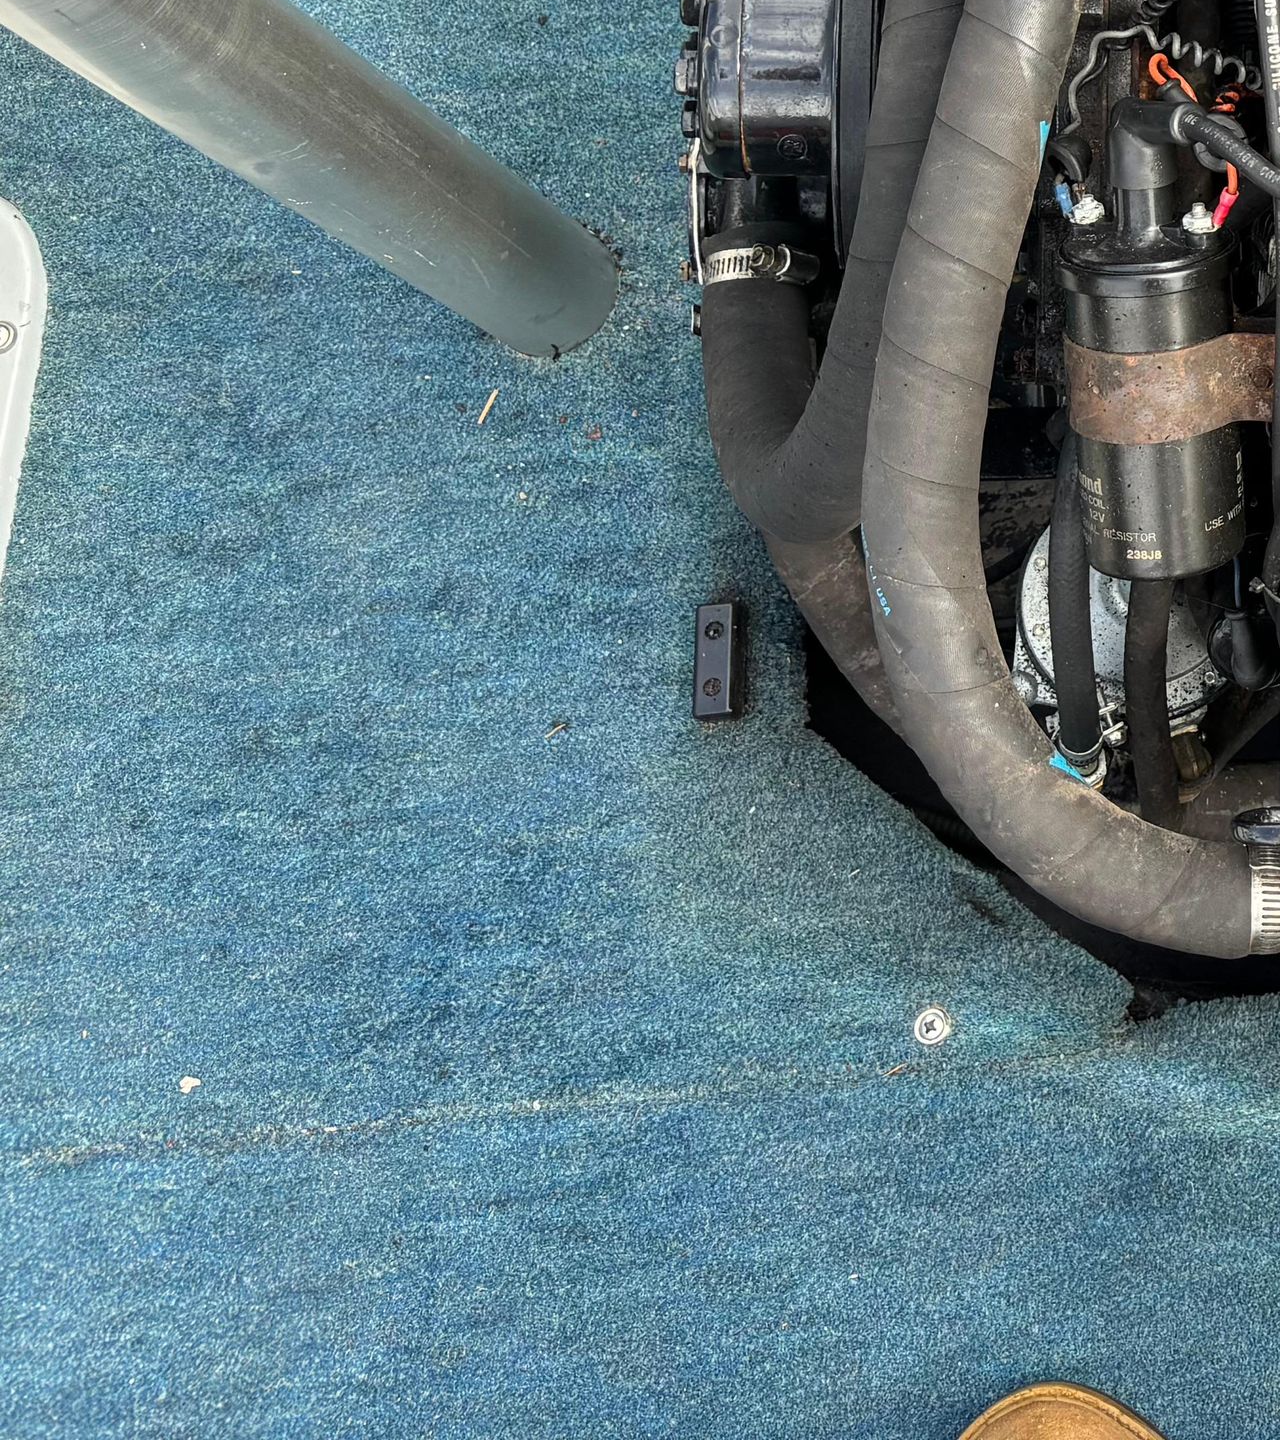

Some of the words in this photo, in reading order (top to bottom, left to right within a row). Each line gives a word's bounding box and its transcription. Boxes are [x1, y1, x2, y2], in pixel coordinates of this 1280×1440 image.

[1204, 515, 1225, 532] USE
[1103, 528, 1157, 543] RESISTOR
[876, 588, 891, 616] USA
